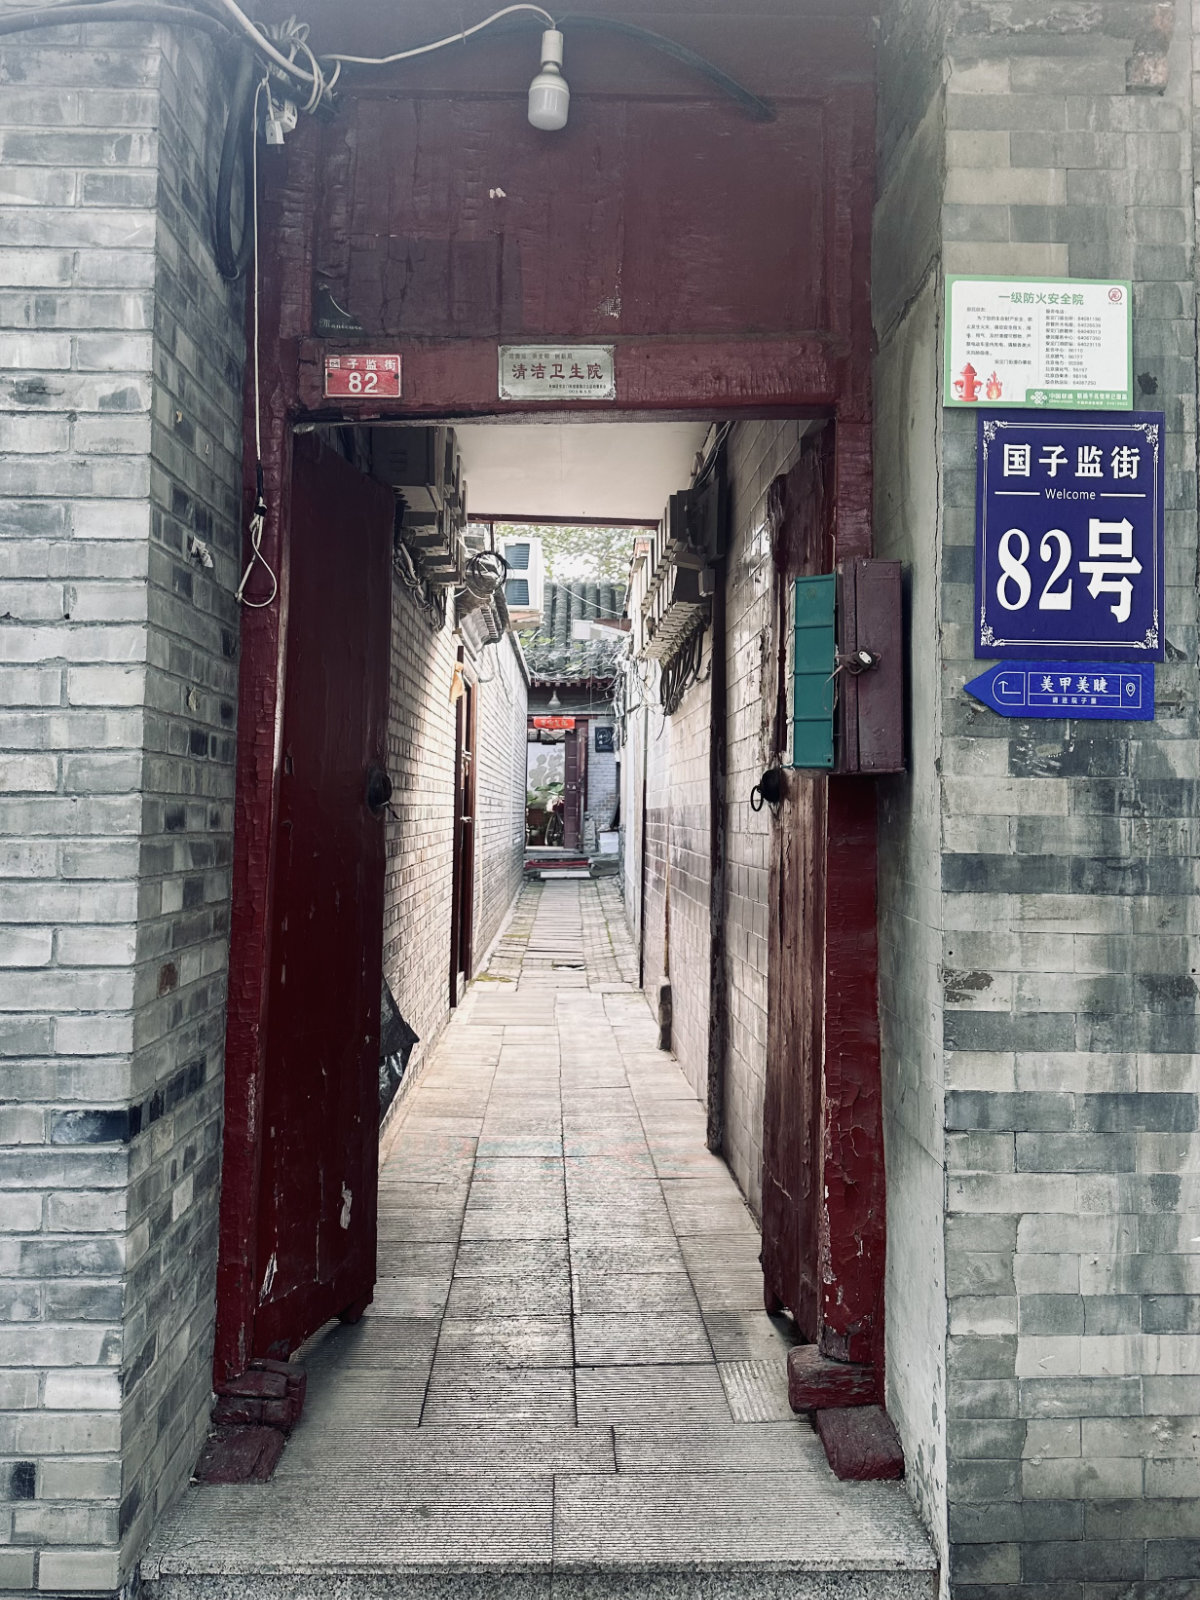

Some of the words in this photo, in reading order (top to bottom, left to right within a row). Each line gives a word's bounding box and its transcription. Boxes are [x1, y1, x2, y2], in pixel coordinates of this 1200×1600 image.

[998, 291, 1084, 305] 一级防火安全院
[329, 358, 396, 371] 国子监街
[512, 363, 603, 380] 清洁卫生院
[348, 372, 378, 393] 82
[1003, 443, 1141, 480] 国子监街
[1045, 488, 1096, 500] Welcome
[996, 517, 1143, 623] 82号
[1040, 675, 1109, 694] 美甲美睫
